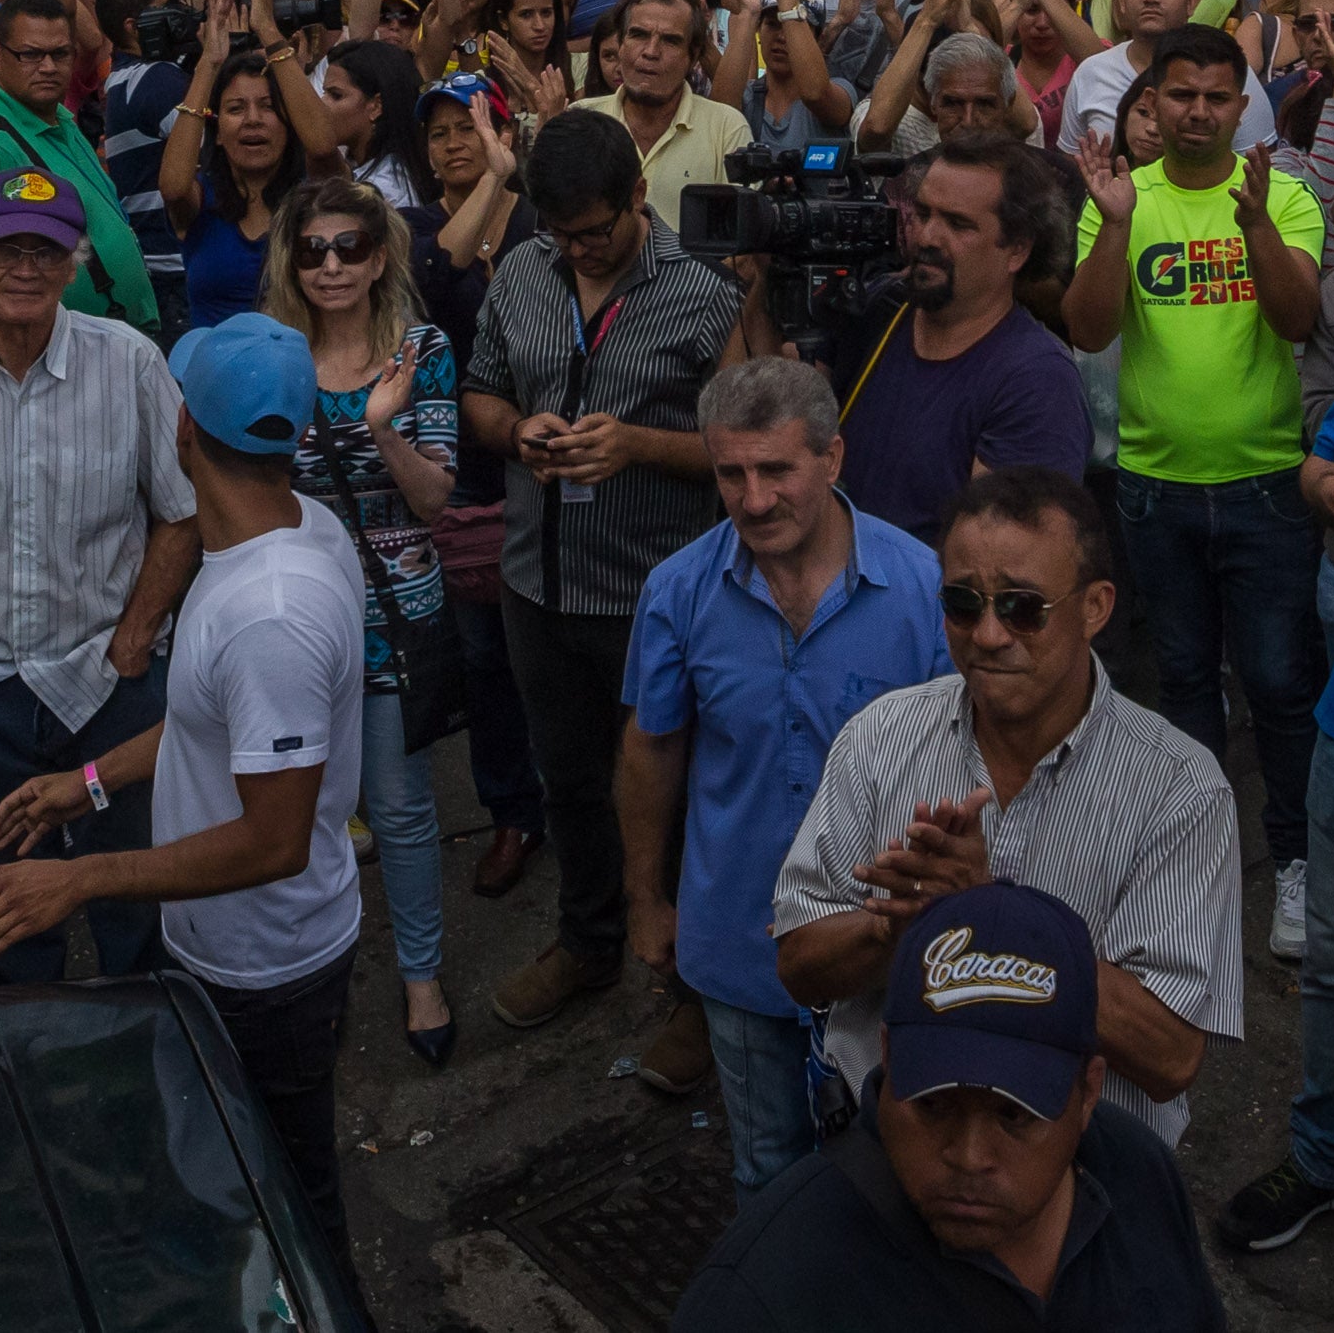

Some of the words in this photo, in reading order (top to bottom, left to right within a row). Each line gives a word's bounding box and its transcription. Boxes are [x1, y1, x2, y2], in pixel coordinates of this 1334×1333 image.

[808, 153, 826, 162] AFP
[1189, 237, 1244, 262] CCS
[1141, 298, 1187, 306] GATORADE
[1190, 279, 1257, 306] 2015
[923, 926, 1058, 994] Caracas
